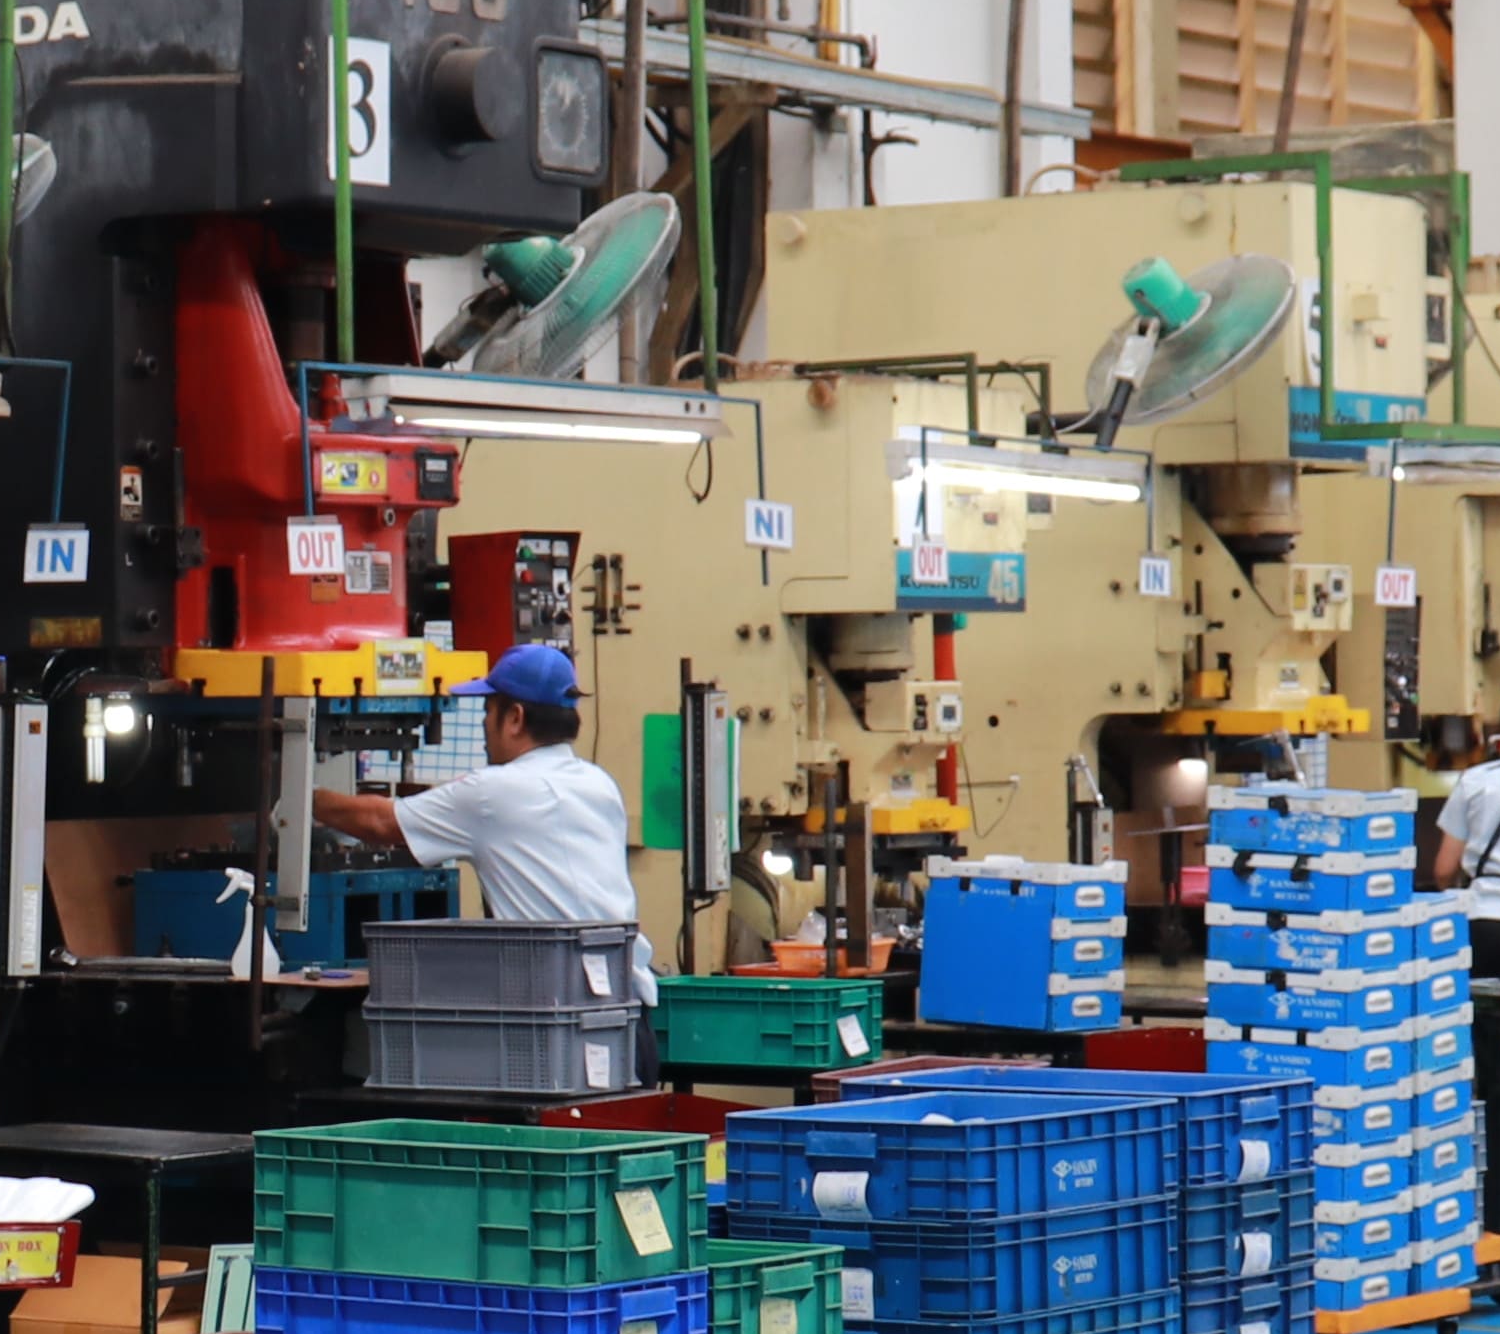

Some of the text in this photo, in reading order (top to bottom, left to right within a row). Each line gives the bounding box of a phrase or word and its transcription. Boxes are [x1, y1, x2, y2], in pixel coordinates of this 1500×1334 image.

[36, 538, 76, 574] IN
[297, 530, 335, 569] OUT
[918, 546, 943, 577] OUT
[900, 576, 981, 590] KTSU
[1145, 563, 1165, 591] IN
[1382, 572, 1410, 601] OUT
[17, 1240, 42, 1252] BOX
